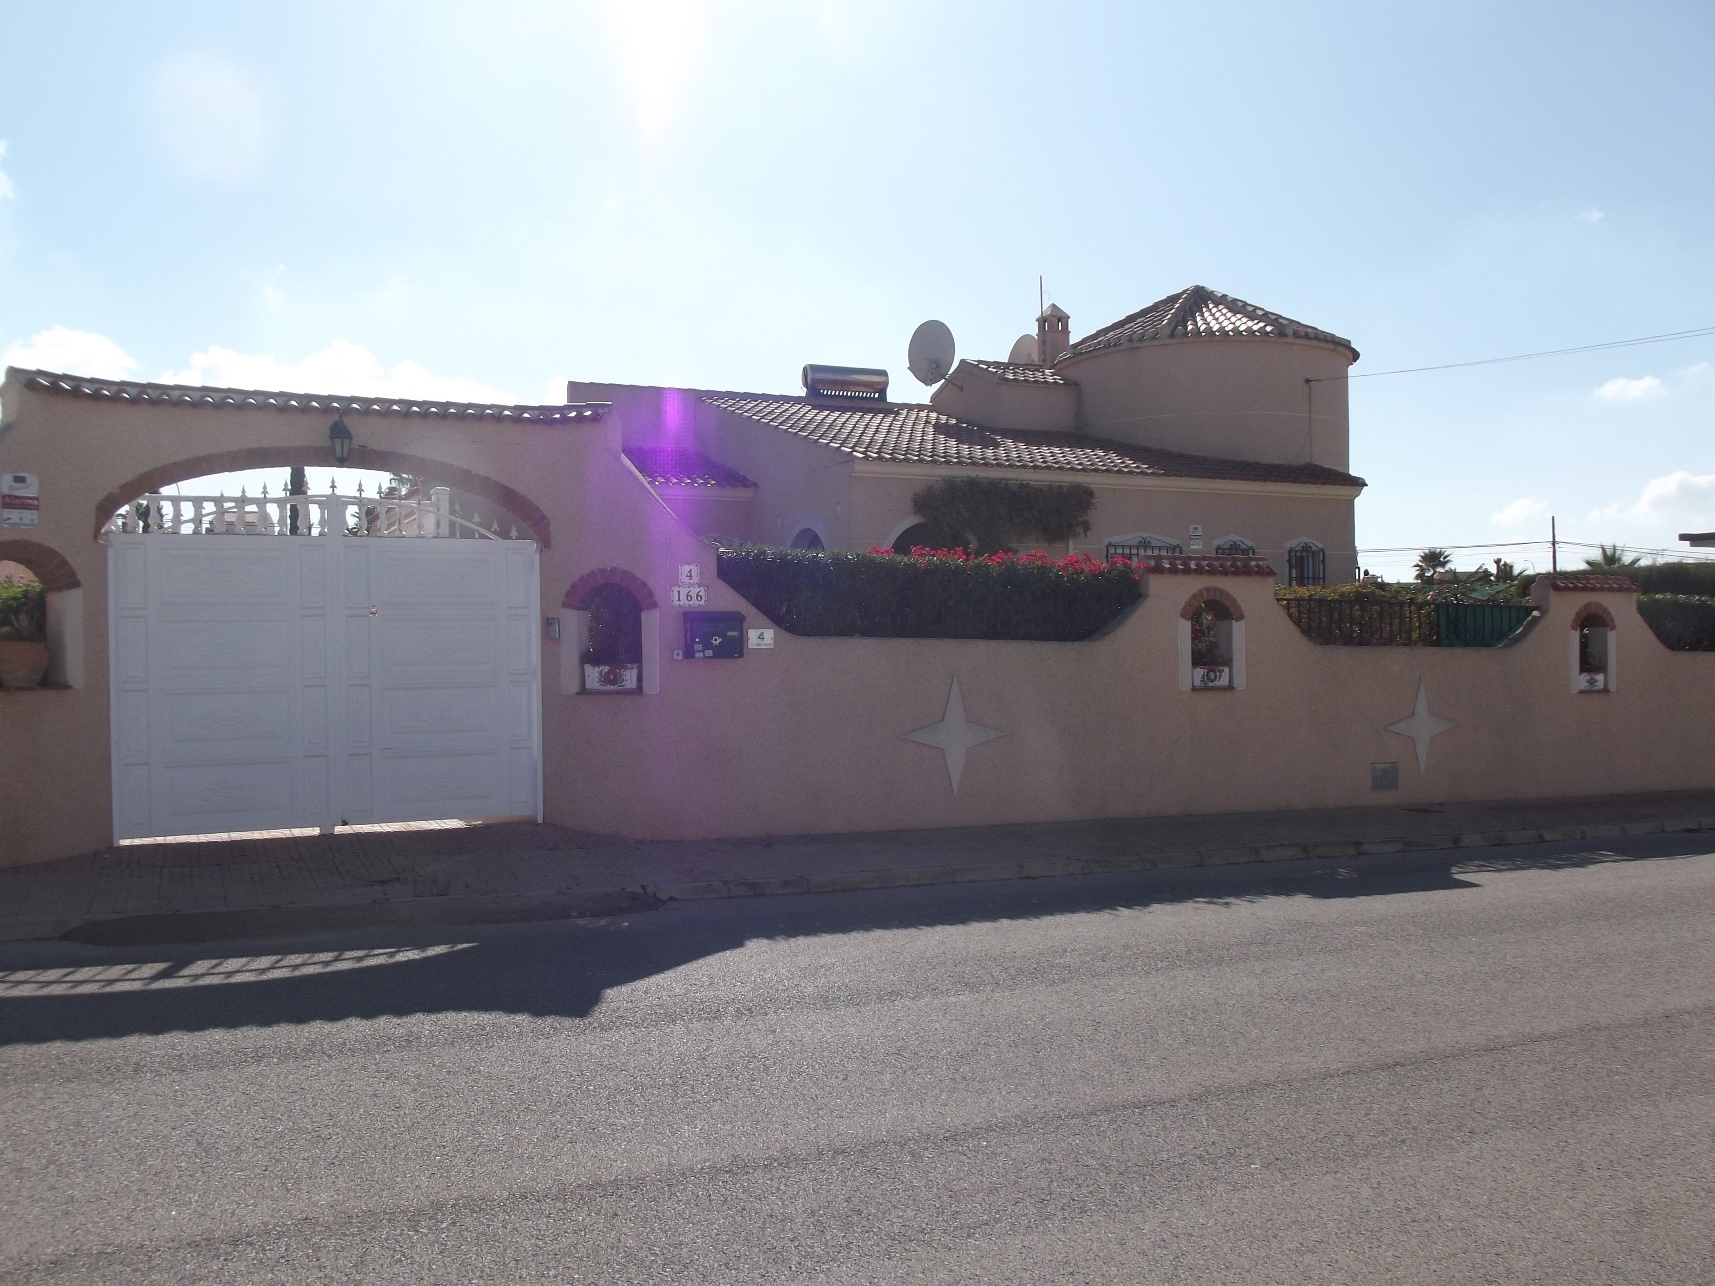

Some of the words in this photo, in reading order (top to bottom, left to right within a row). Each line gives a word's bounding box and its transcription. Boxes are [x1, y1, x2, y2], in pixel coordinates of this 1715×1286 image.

[685, 568, 693, 580] 4
[676, 590, 703, 602] 166
[757, 631, 765, 641] 4
